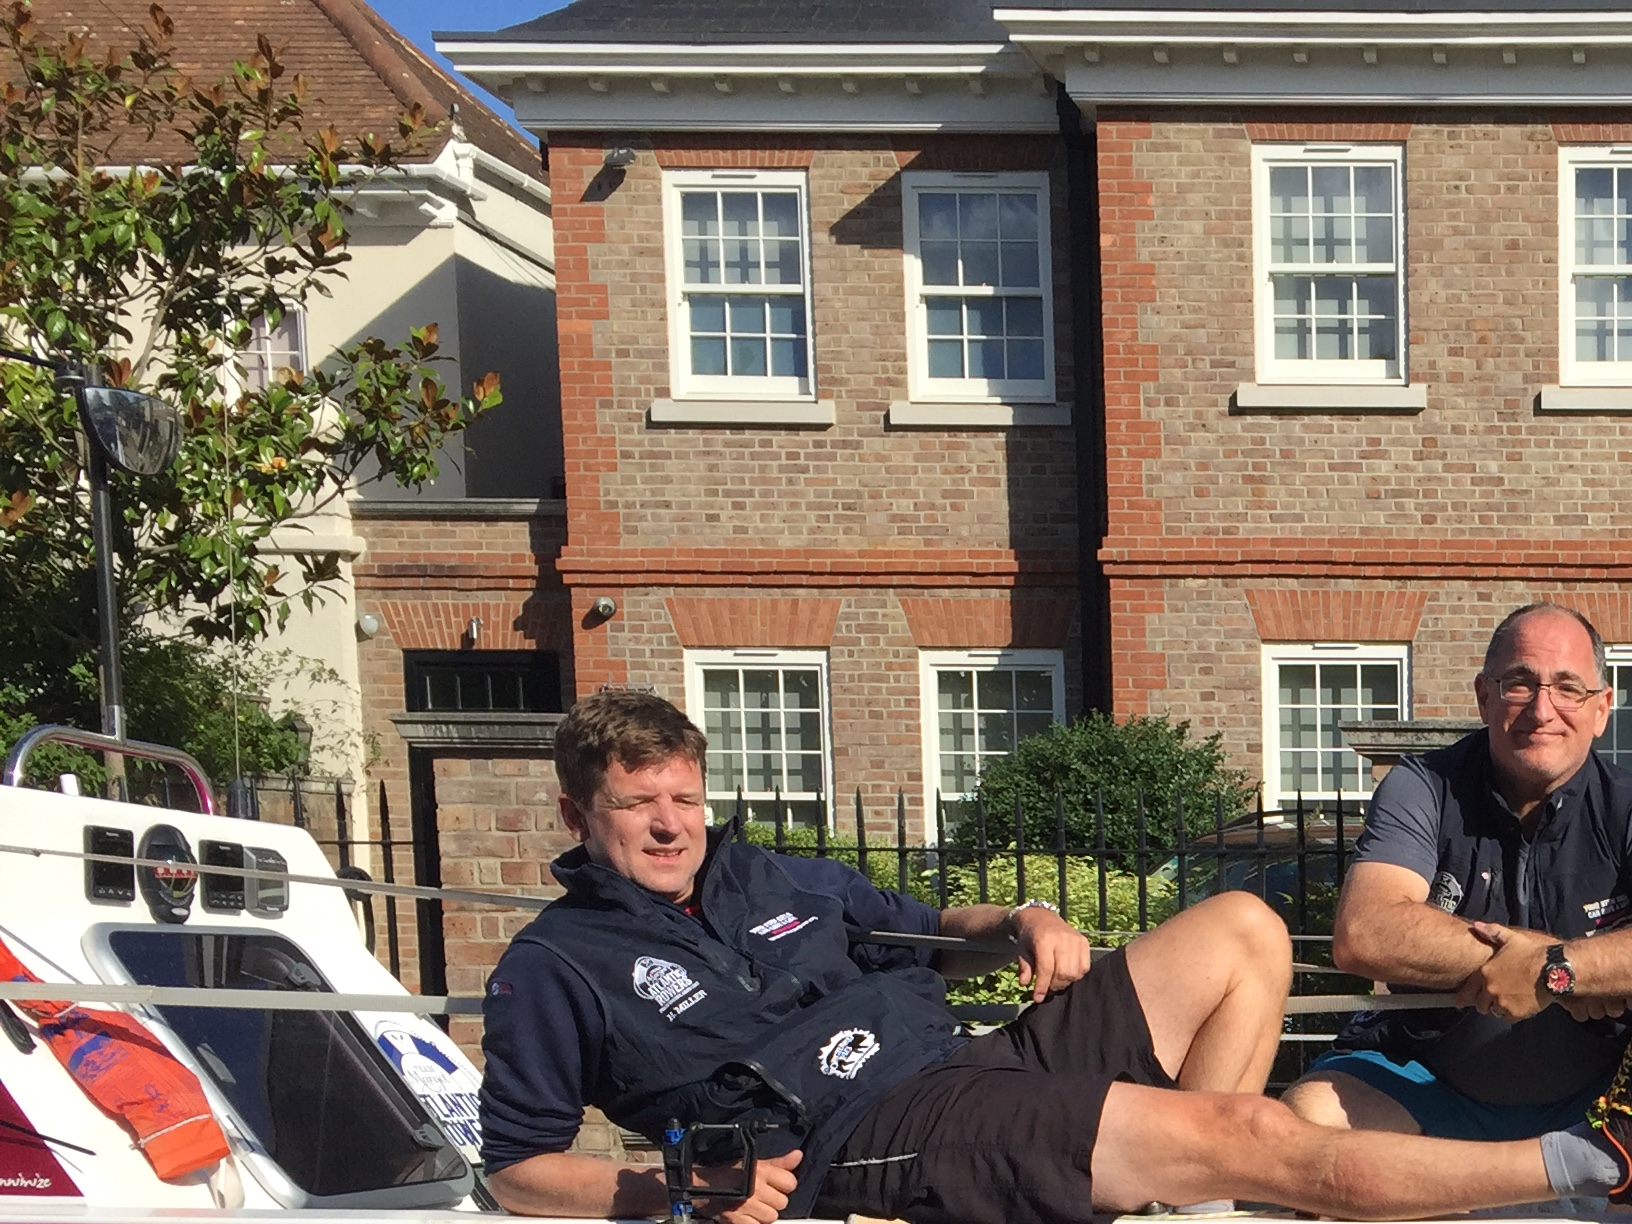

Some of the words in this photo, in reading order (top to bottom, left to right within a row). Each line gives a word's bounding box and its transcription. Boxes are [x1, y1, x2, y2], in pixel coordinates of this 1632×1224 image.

[647, 968, 687, 997] ATLANTIC
[654, 976, 693, 1007] ROWERS
[673, 989, 708, 1015] MILLER
